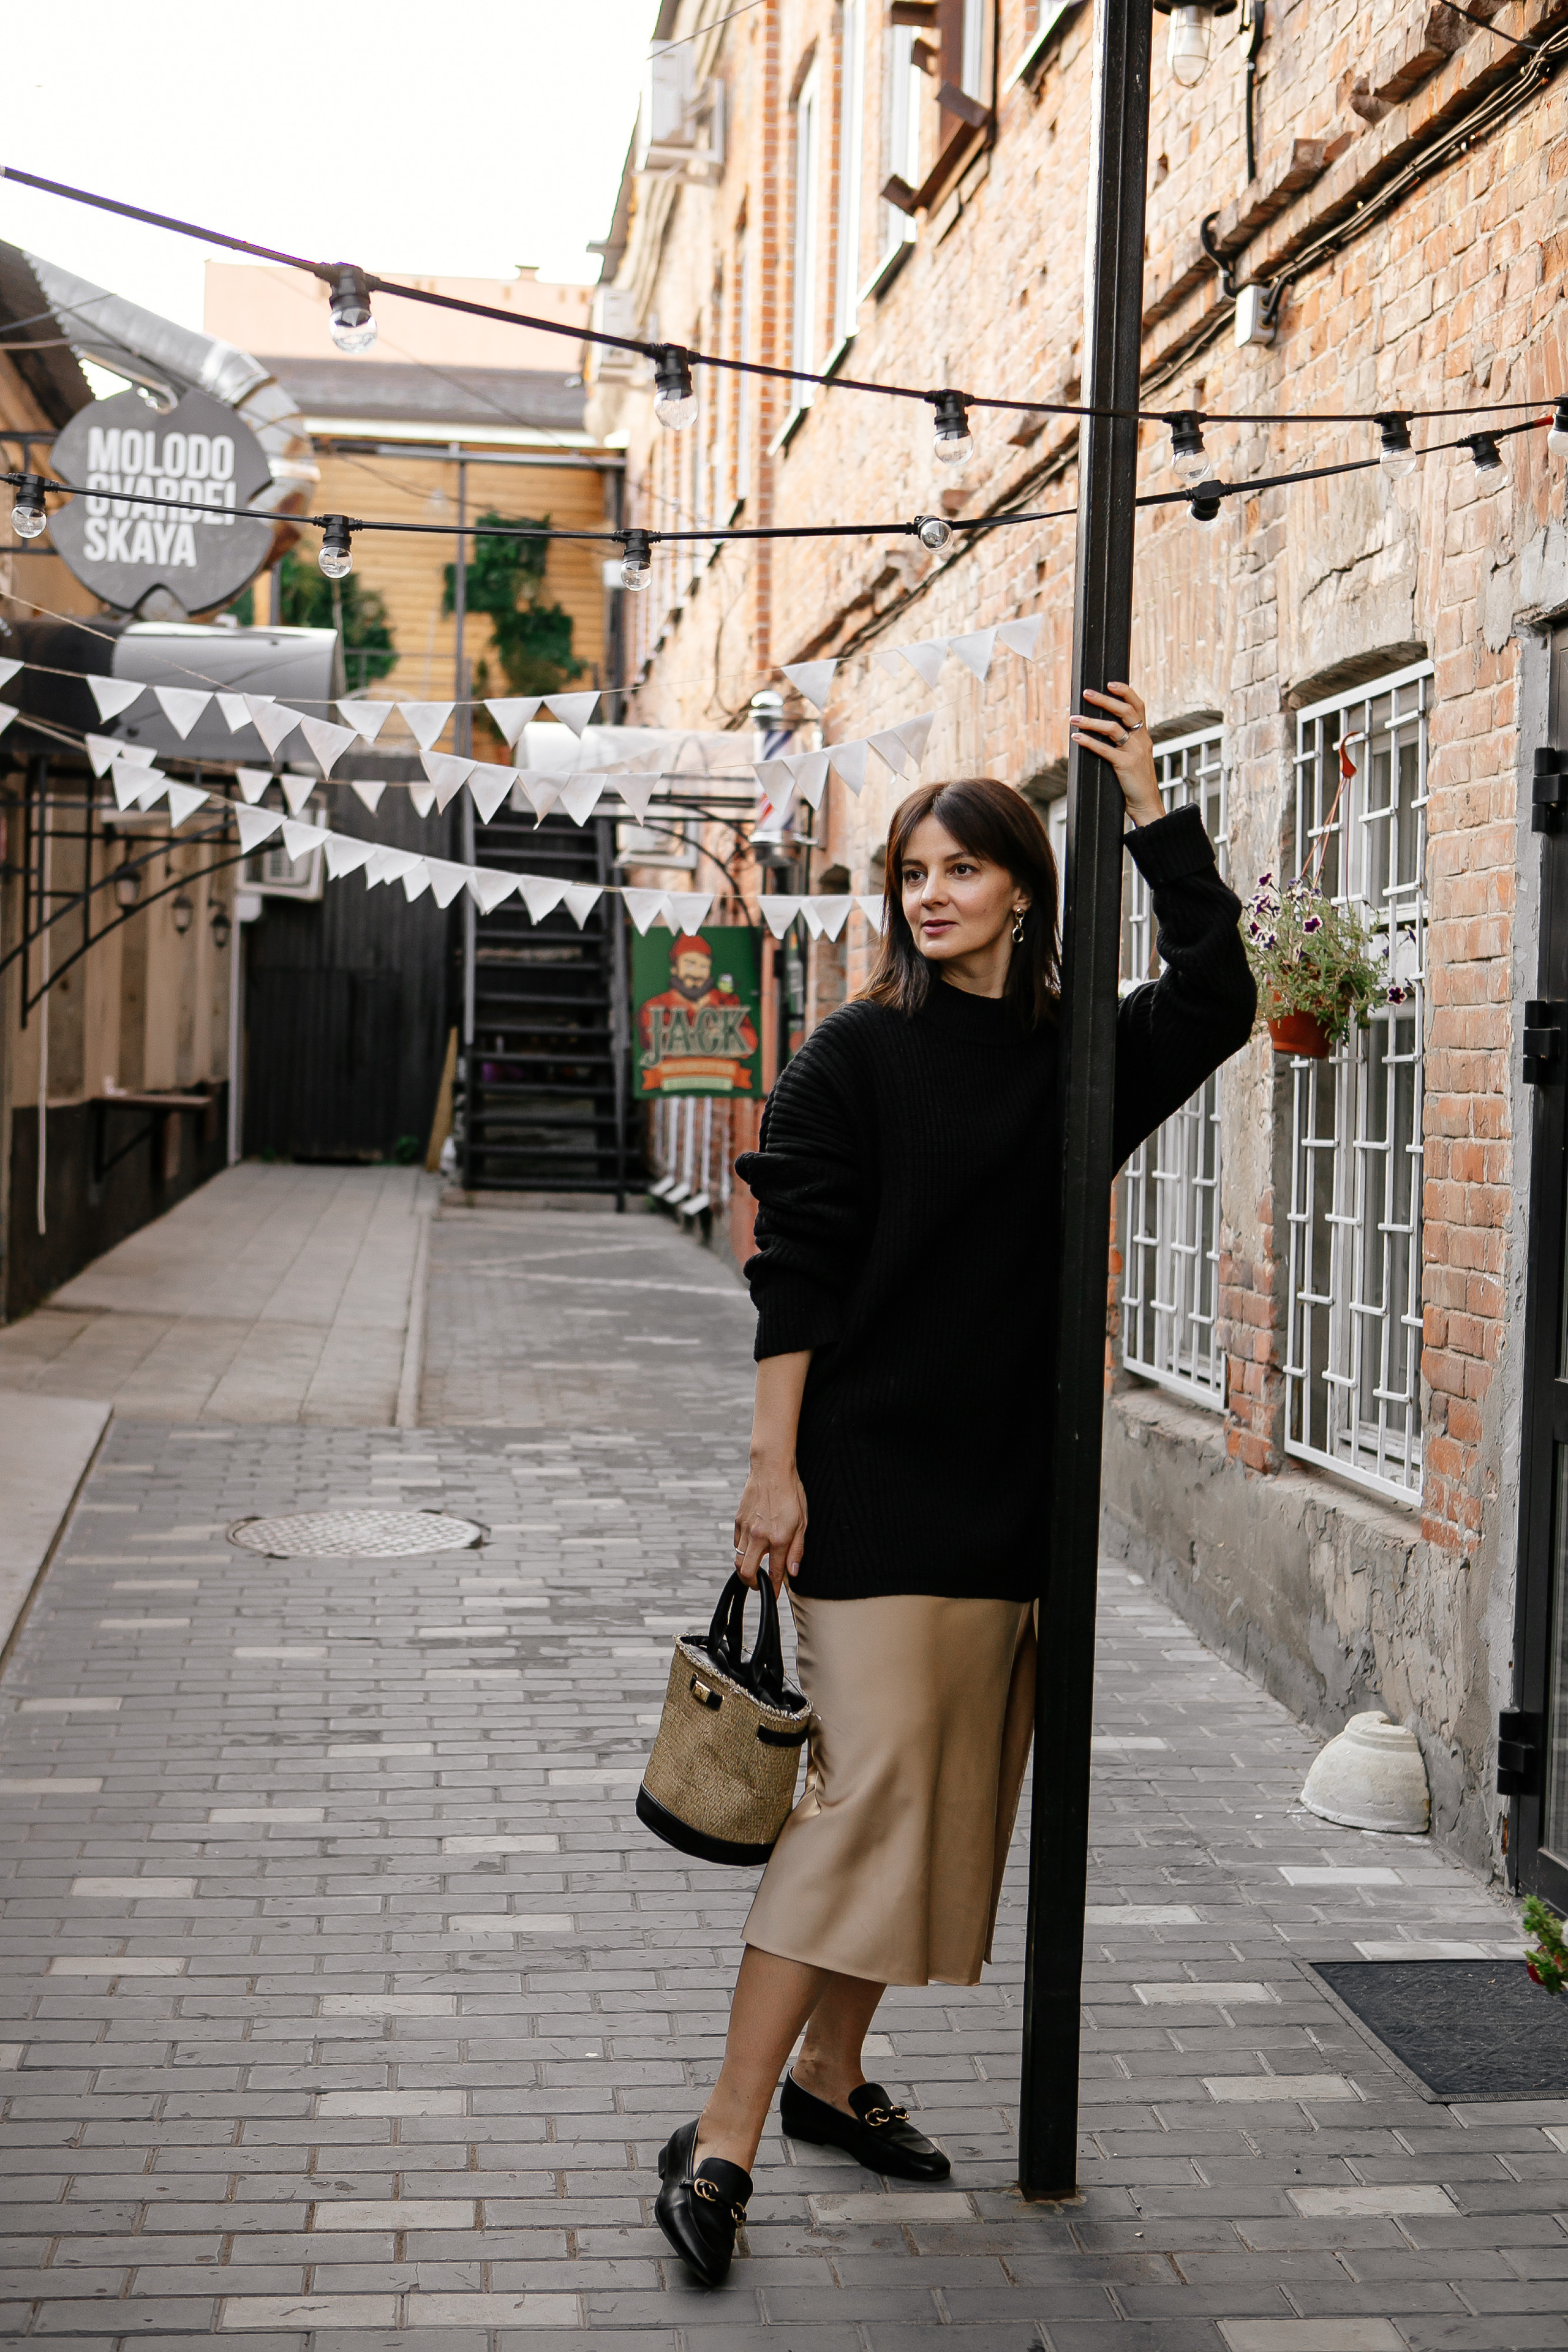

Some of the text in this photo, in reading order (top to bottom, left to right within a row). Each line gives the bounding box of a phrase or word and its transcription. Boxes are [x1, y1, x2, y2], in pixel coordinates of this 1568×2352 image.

[88, 427, 235, 481] MOLODO
[83, 518, 197, 567] SKAYA
[640, 1006, 750, 1067] JACK
